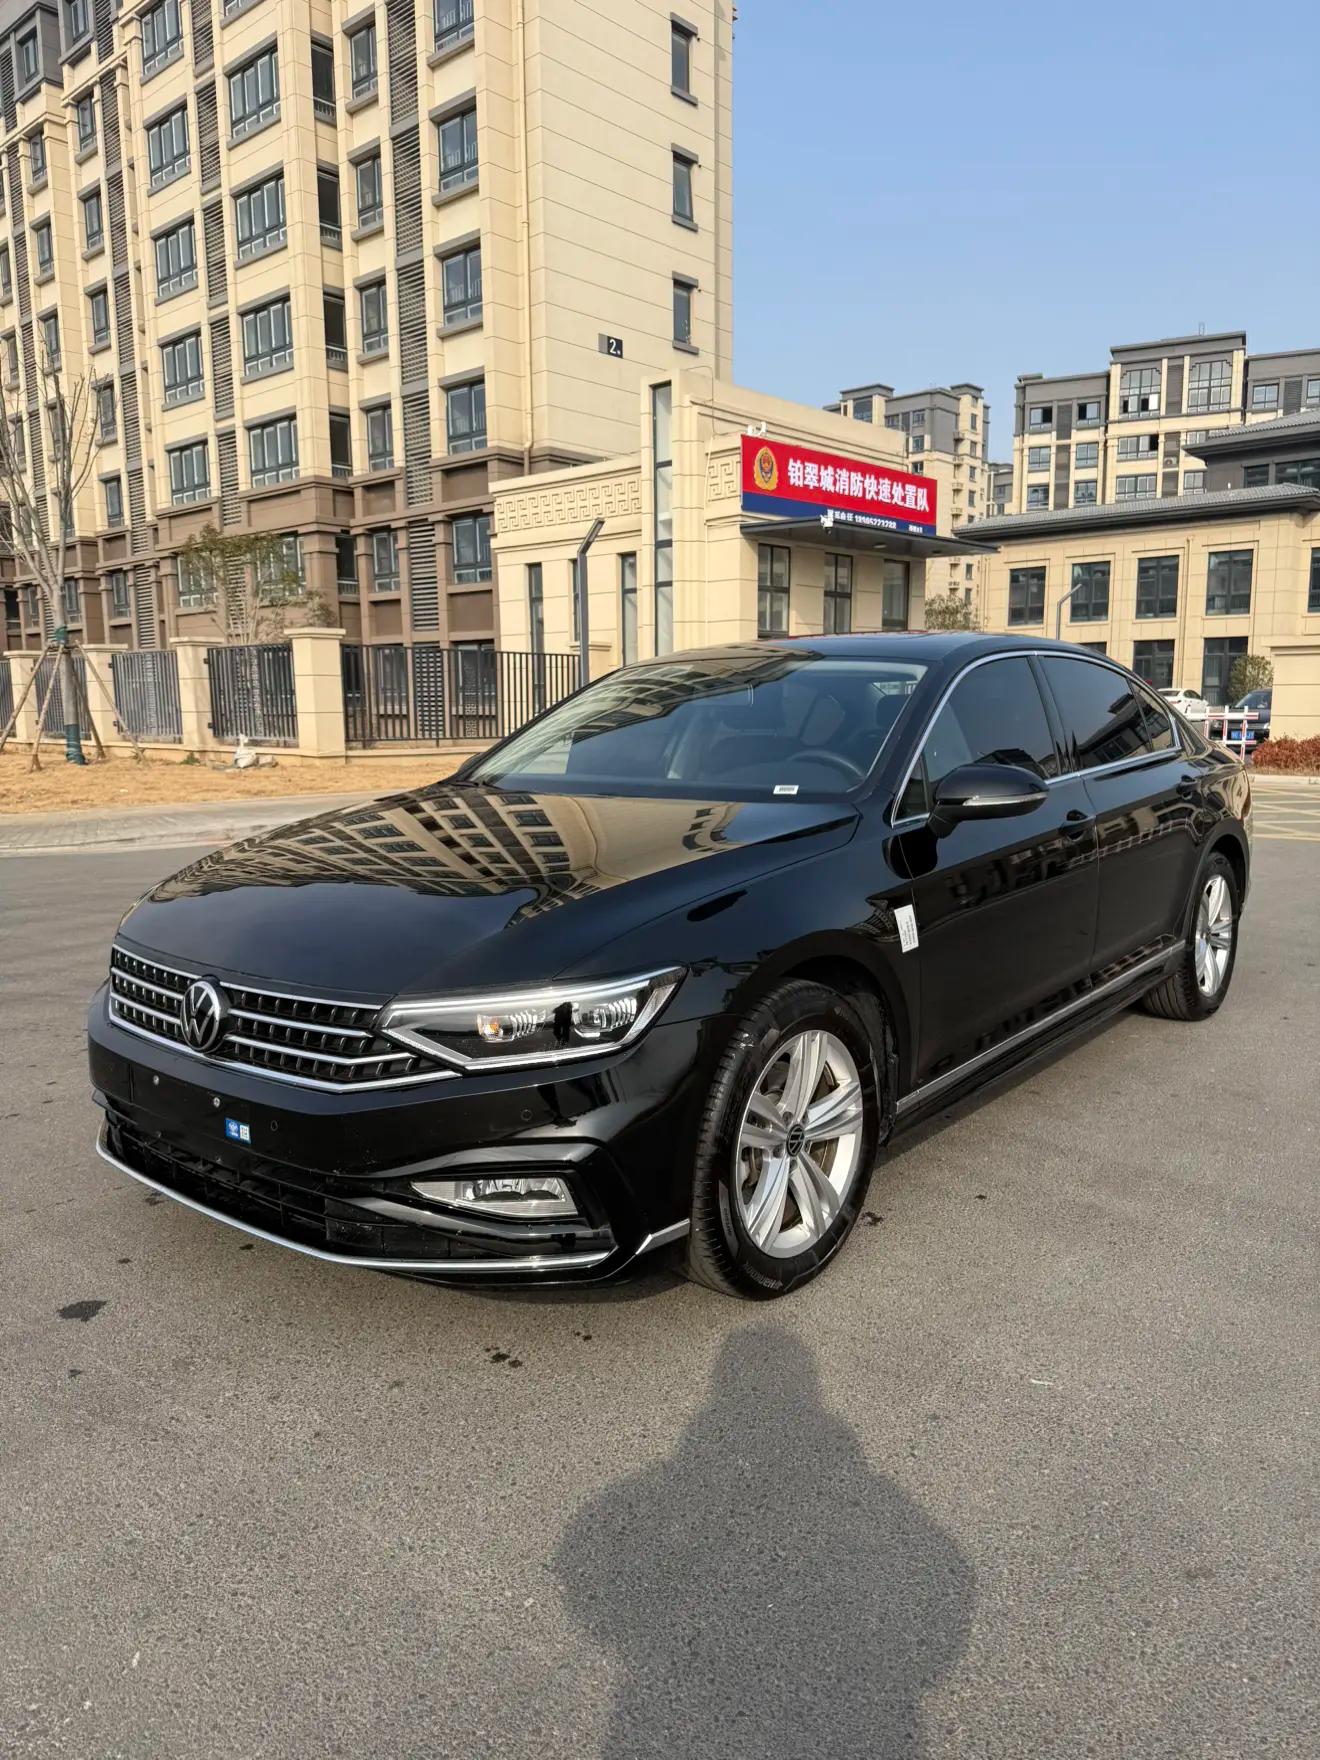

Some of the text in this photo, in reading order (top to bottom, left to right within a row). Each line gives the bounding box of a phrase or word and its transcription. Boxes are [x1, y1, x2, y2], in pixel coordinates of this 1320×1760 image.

[788, 458, 930, 512] 铂翠城消防快速处置队
